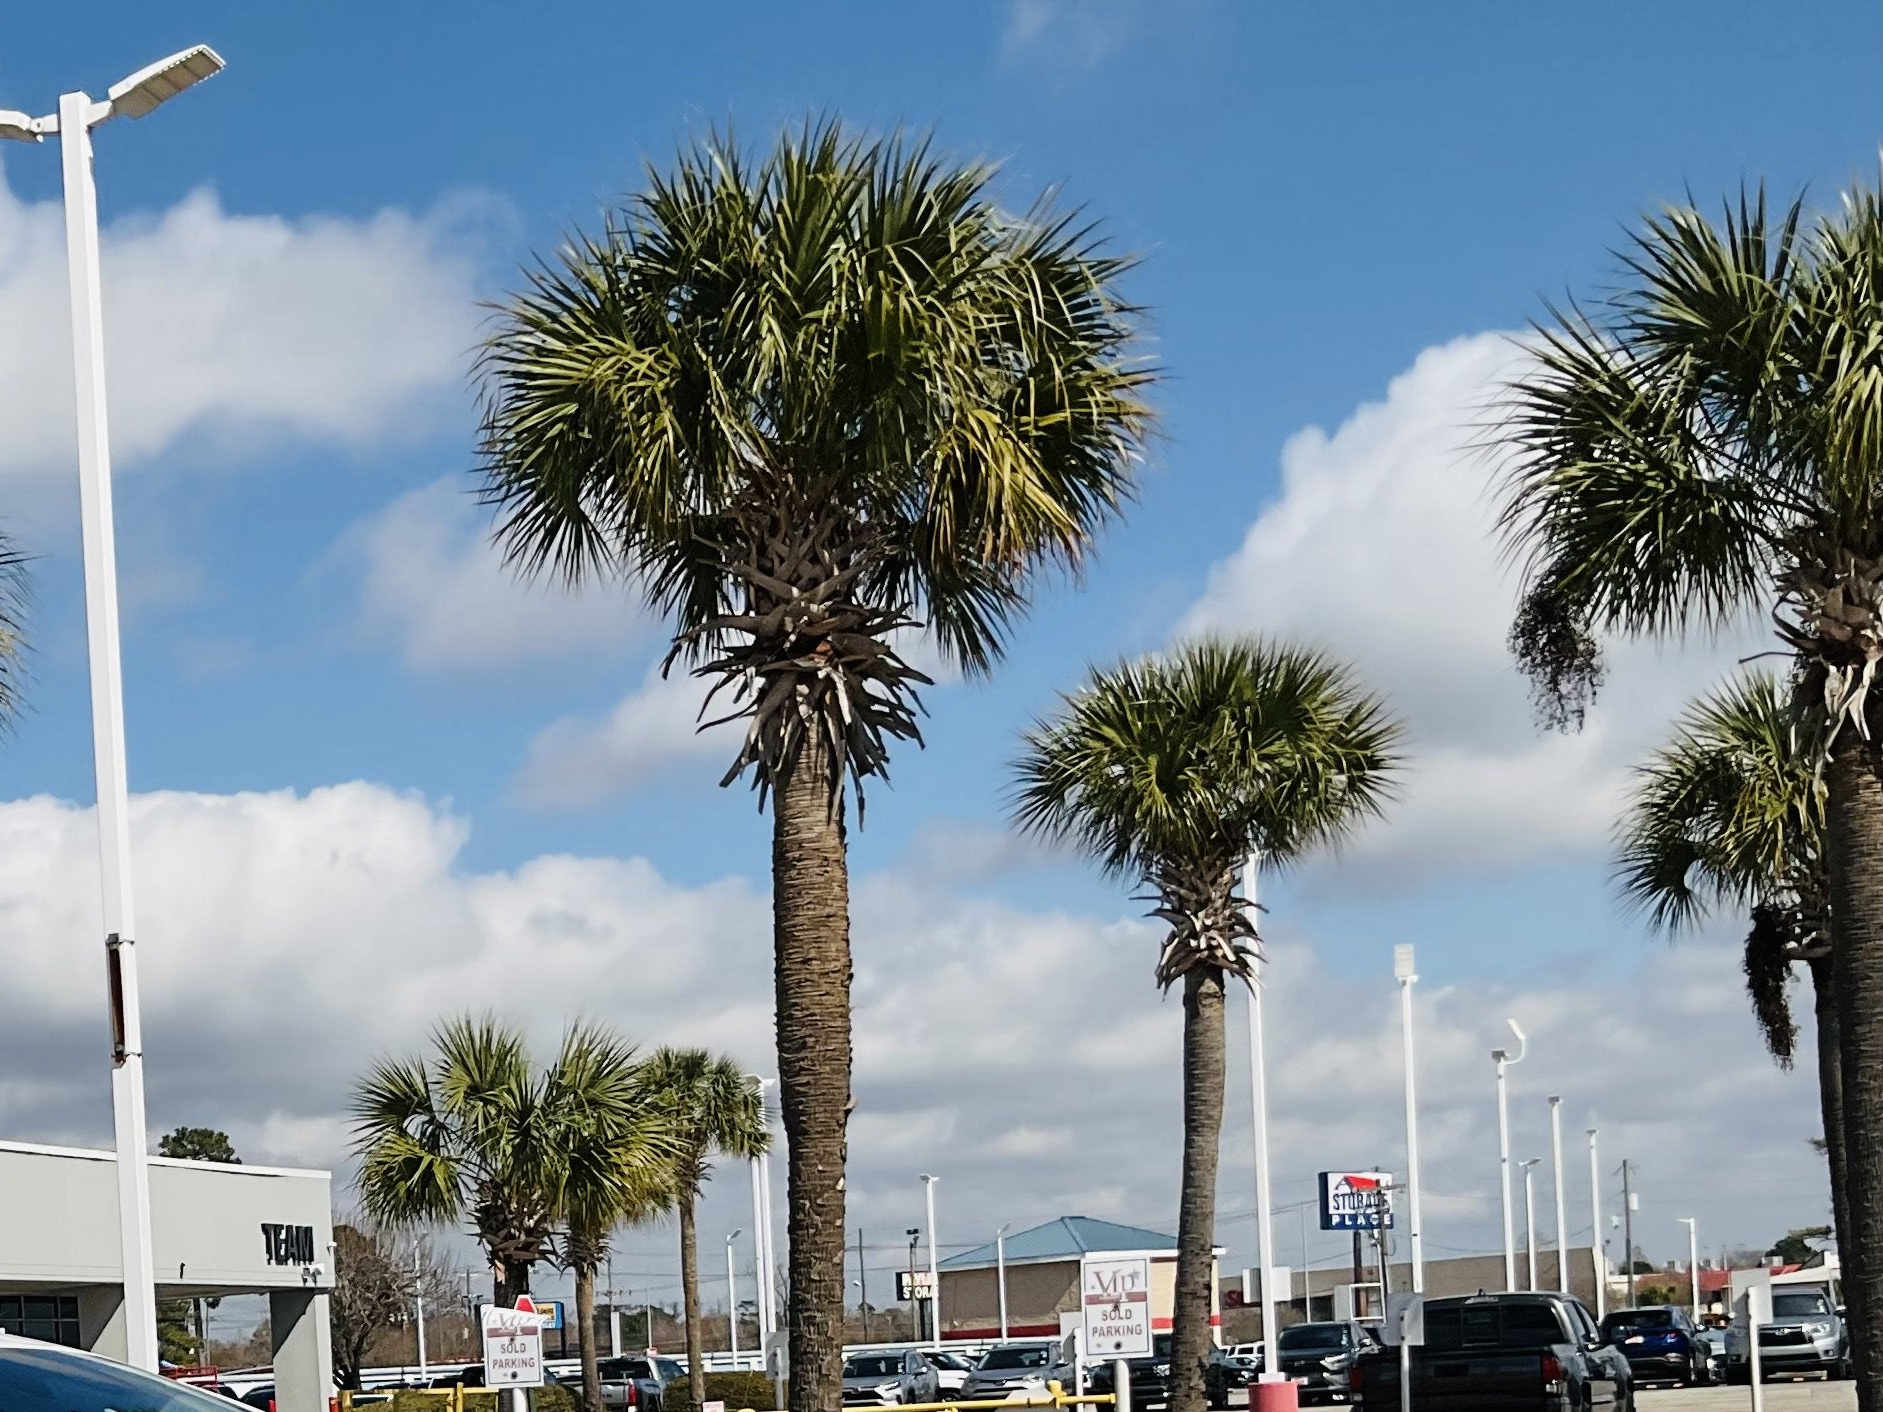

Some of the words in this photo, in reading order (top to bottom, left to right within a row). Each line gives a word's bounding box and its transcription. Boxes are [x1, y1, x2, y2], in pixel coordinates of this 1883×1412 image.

[1332, 1192, 1384, 1210] STORA
[260, 1223, 315, 1264] TEAM
[1101, 1308, 1132, 1321] SOLD
[1092, 1323, 1143, 1337] PARKING
[500, 1342, 527, 1354] SOLD
[492, 1357, 535, 1369] PARKING
